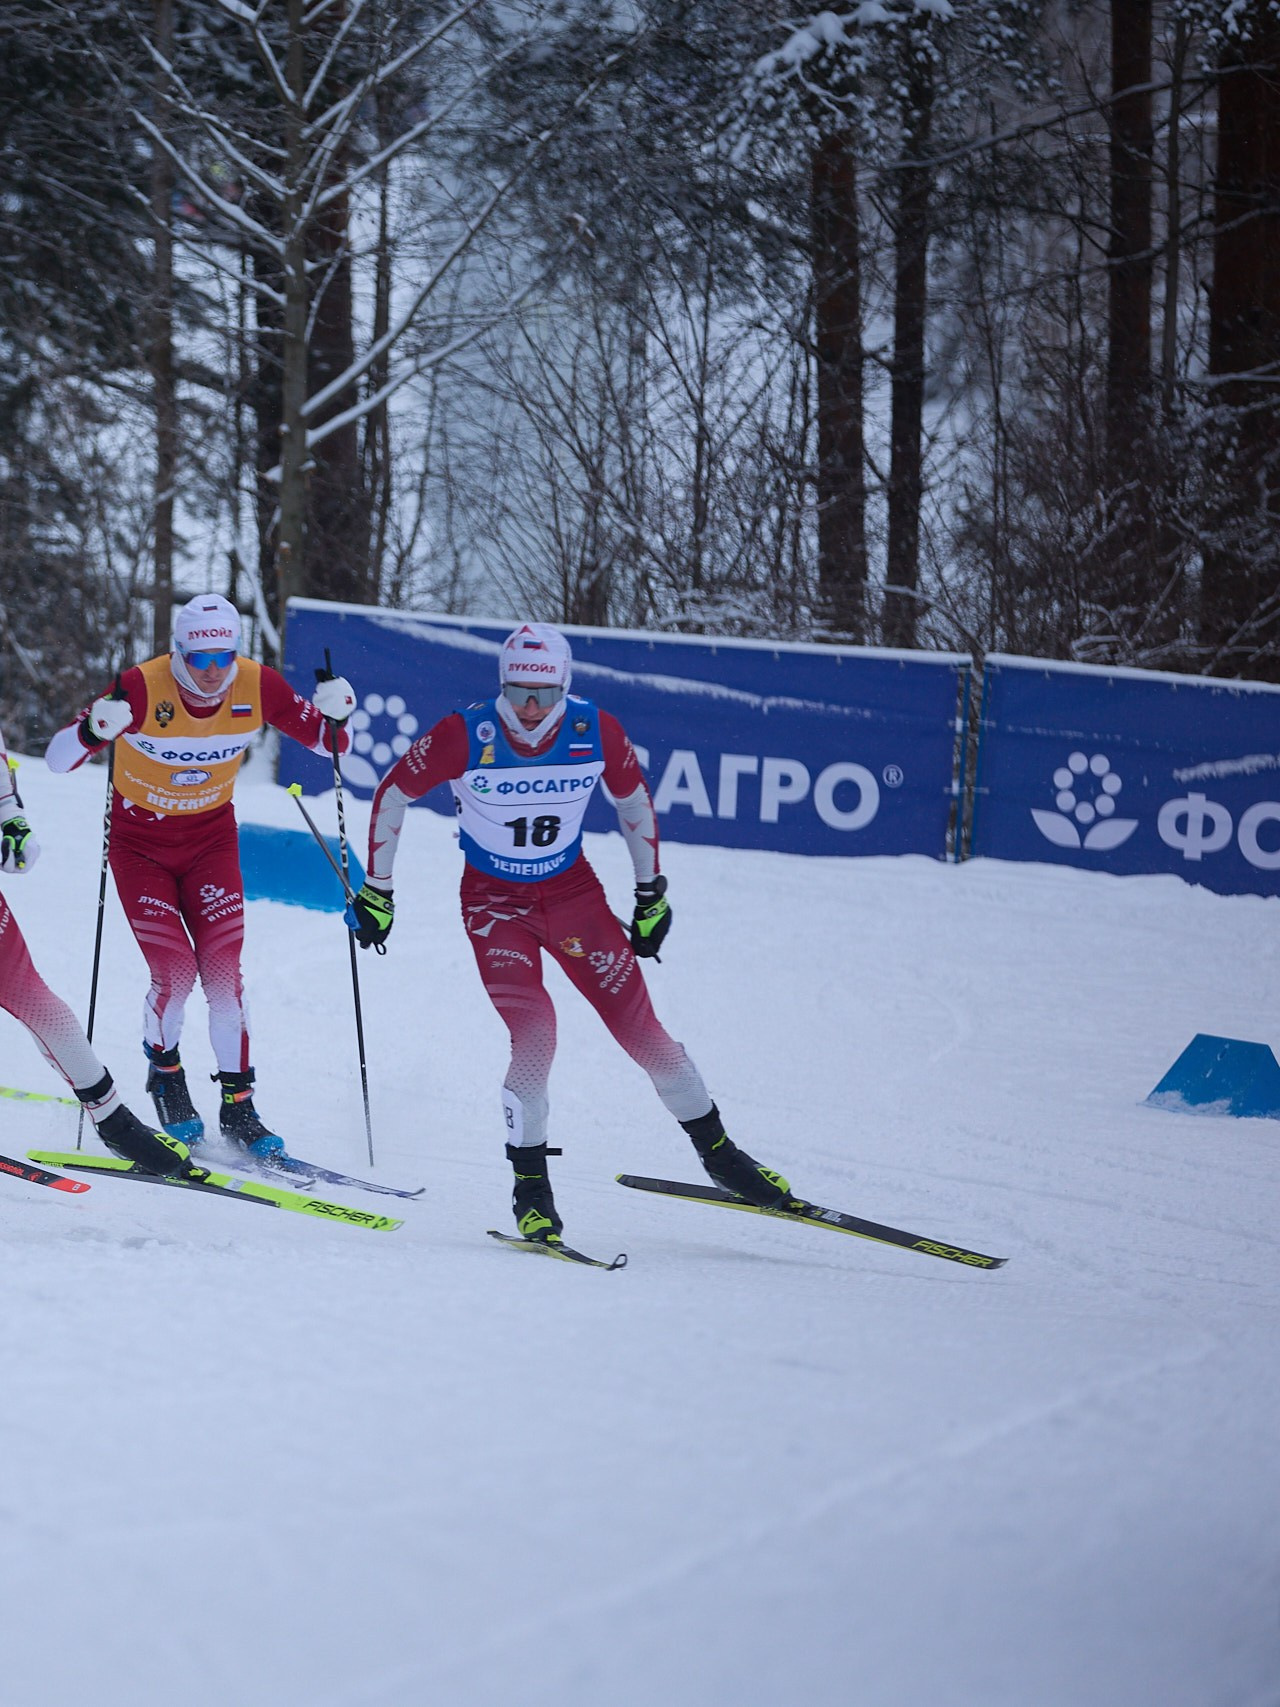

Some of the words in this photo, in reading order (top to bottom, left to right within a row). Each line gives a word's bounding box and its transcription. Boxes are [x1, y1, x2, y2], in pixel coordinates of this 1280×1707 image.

[188, 627, 233, 640] ЛУКОЙЛ
[507, 662, 557, 674] ЛУКОЙЛ
[496, 776, 594, 795] ФОСАГРО
[504, 815, 561, 847] 18
[200, 892, 241, 915] ФОСАГРО
[486, 948, 534, 968] ЛУКОЙЛ
[600, 947, 629, 989] ФОСАГРО
[303, 1200, 376, 1225] FISCHER
[912, 1240, 994, 1268] FISCHER
